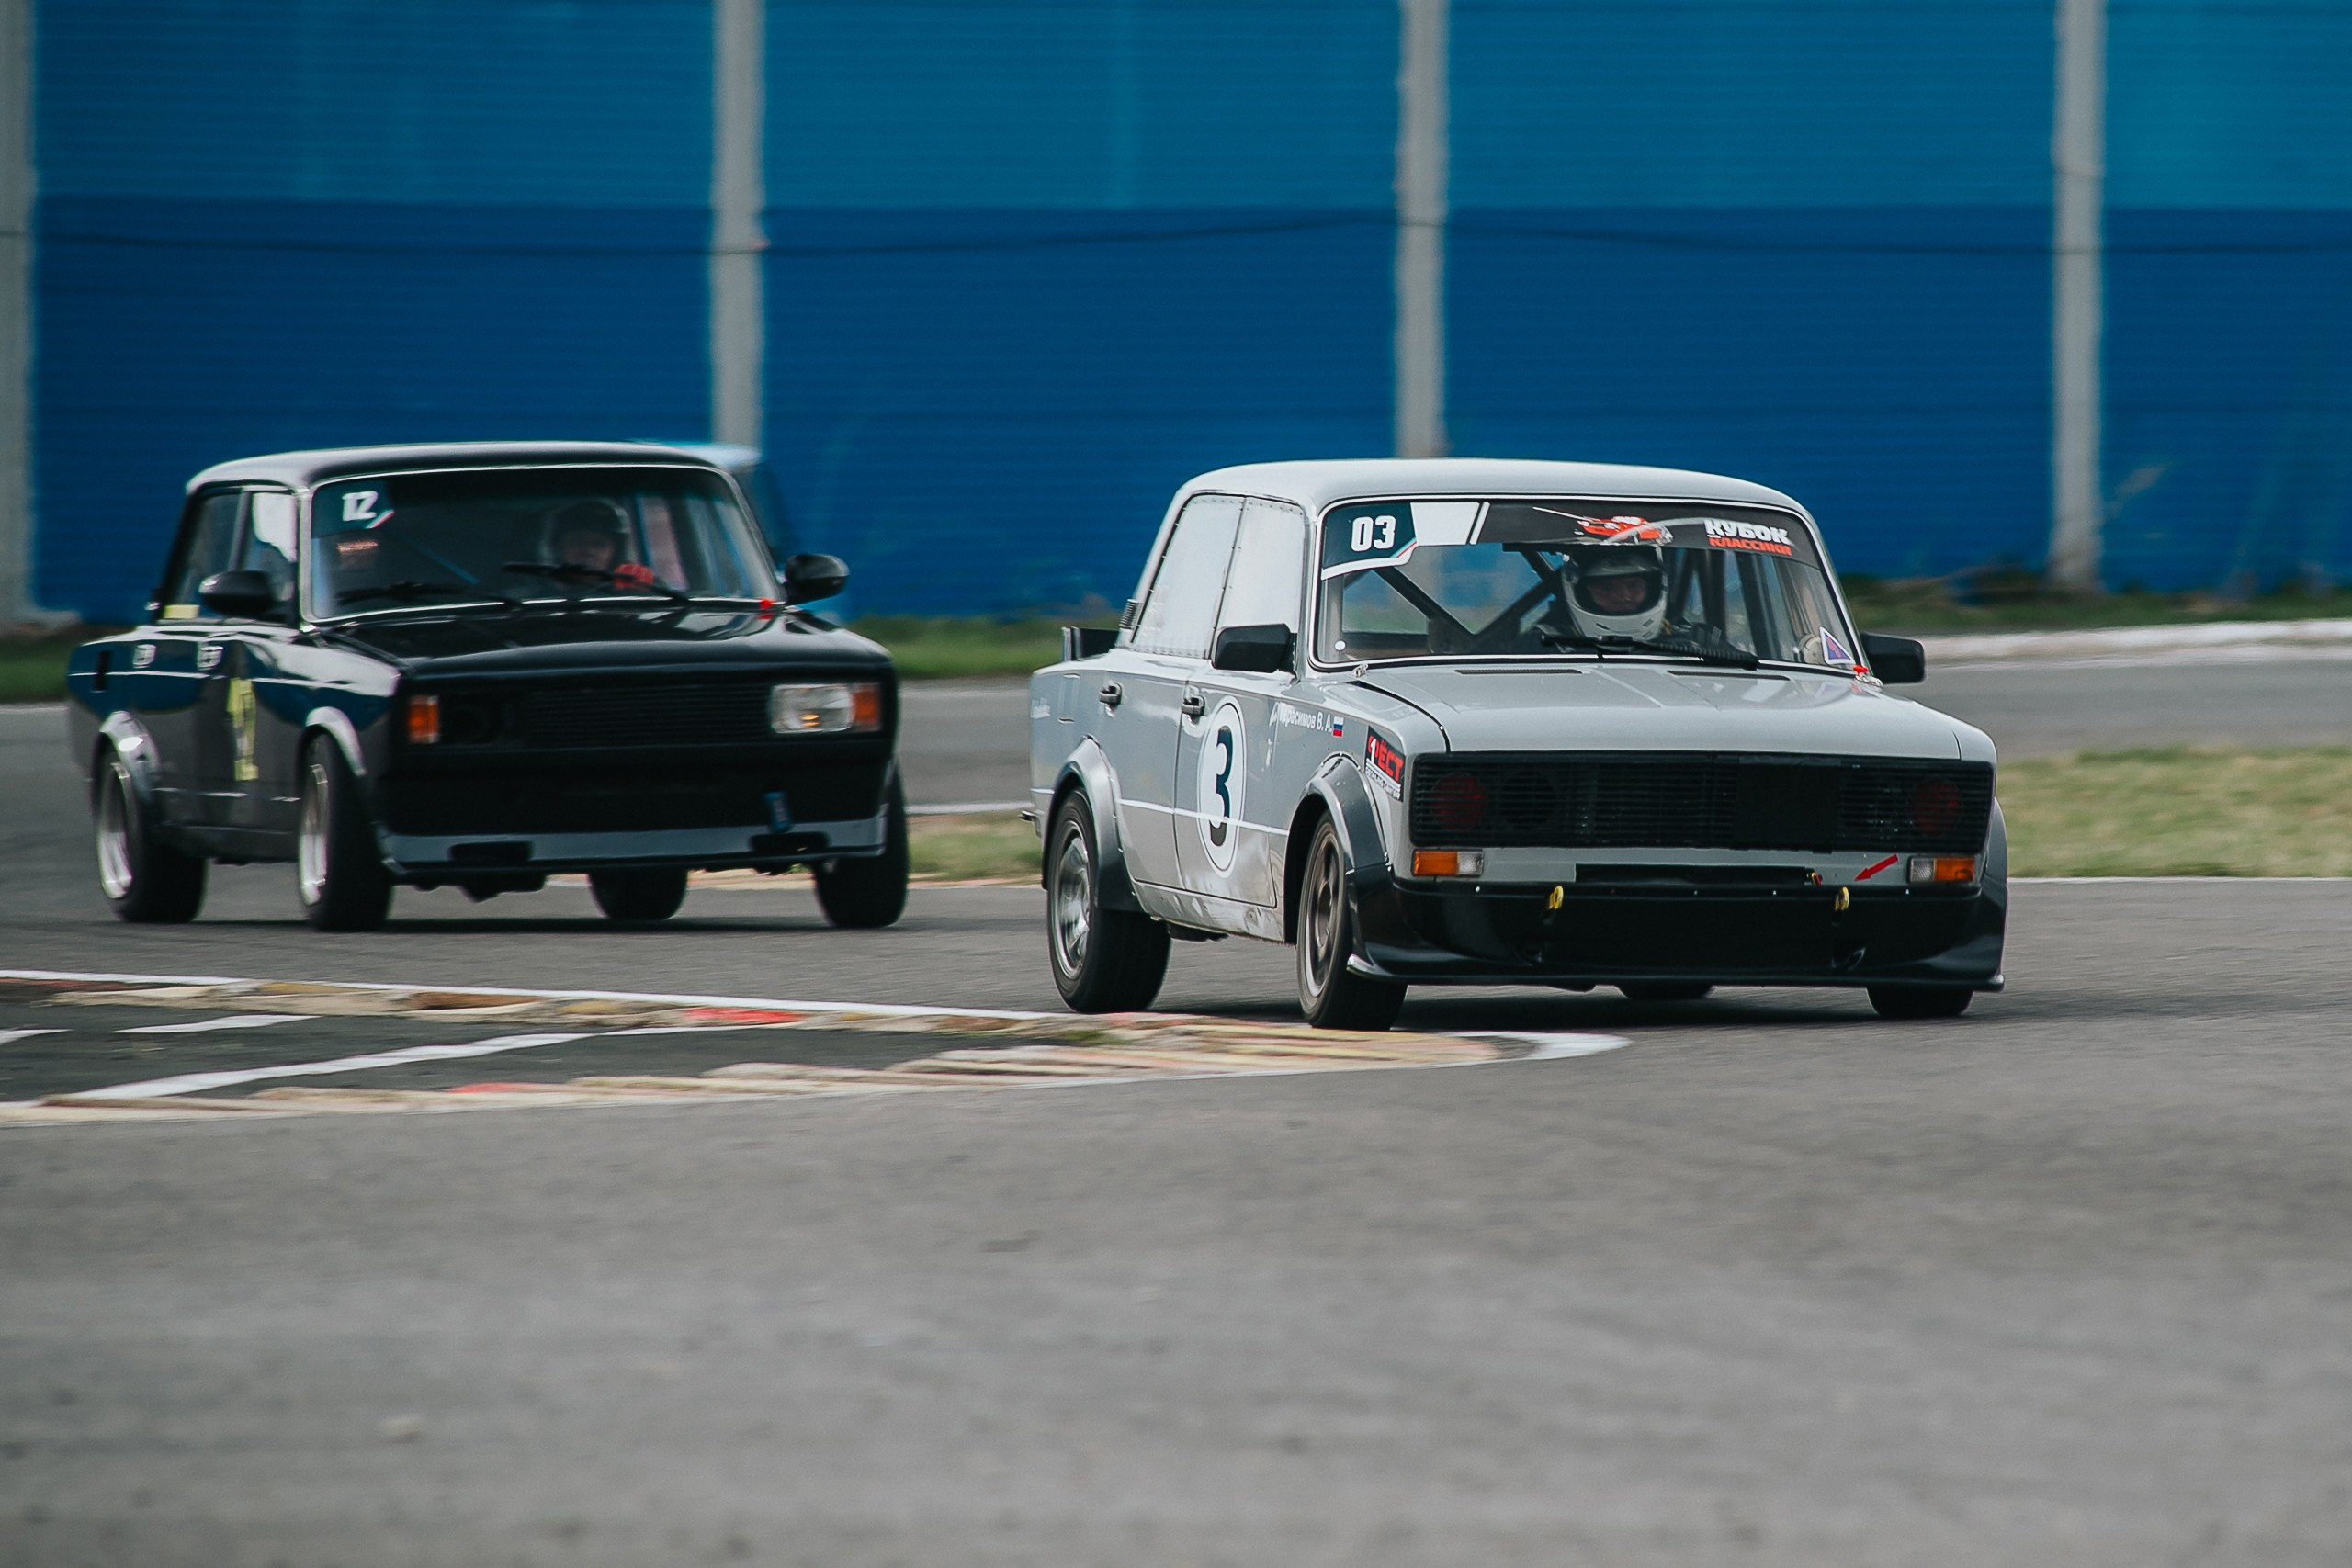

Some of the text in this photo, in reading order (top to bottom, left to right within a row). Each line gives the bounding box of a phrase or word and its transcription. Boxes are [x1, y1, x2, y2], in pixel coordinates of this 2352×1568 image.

[342, 491, 379, 522] 12
[1351, 514, 1396, 552] 03
[1703, 519, 1792, 546] КУБОК
[1208, 725, 1234, 847] 3
